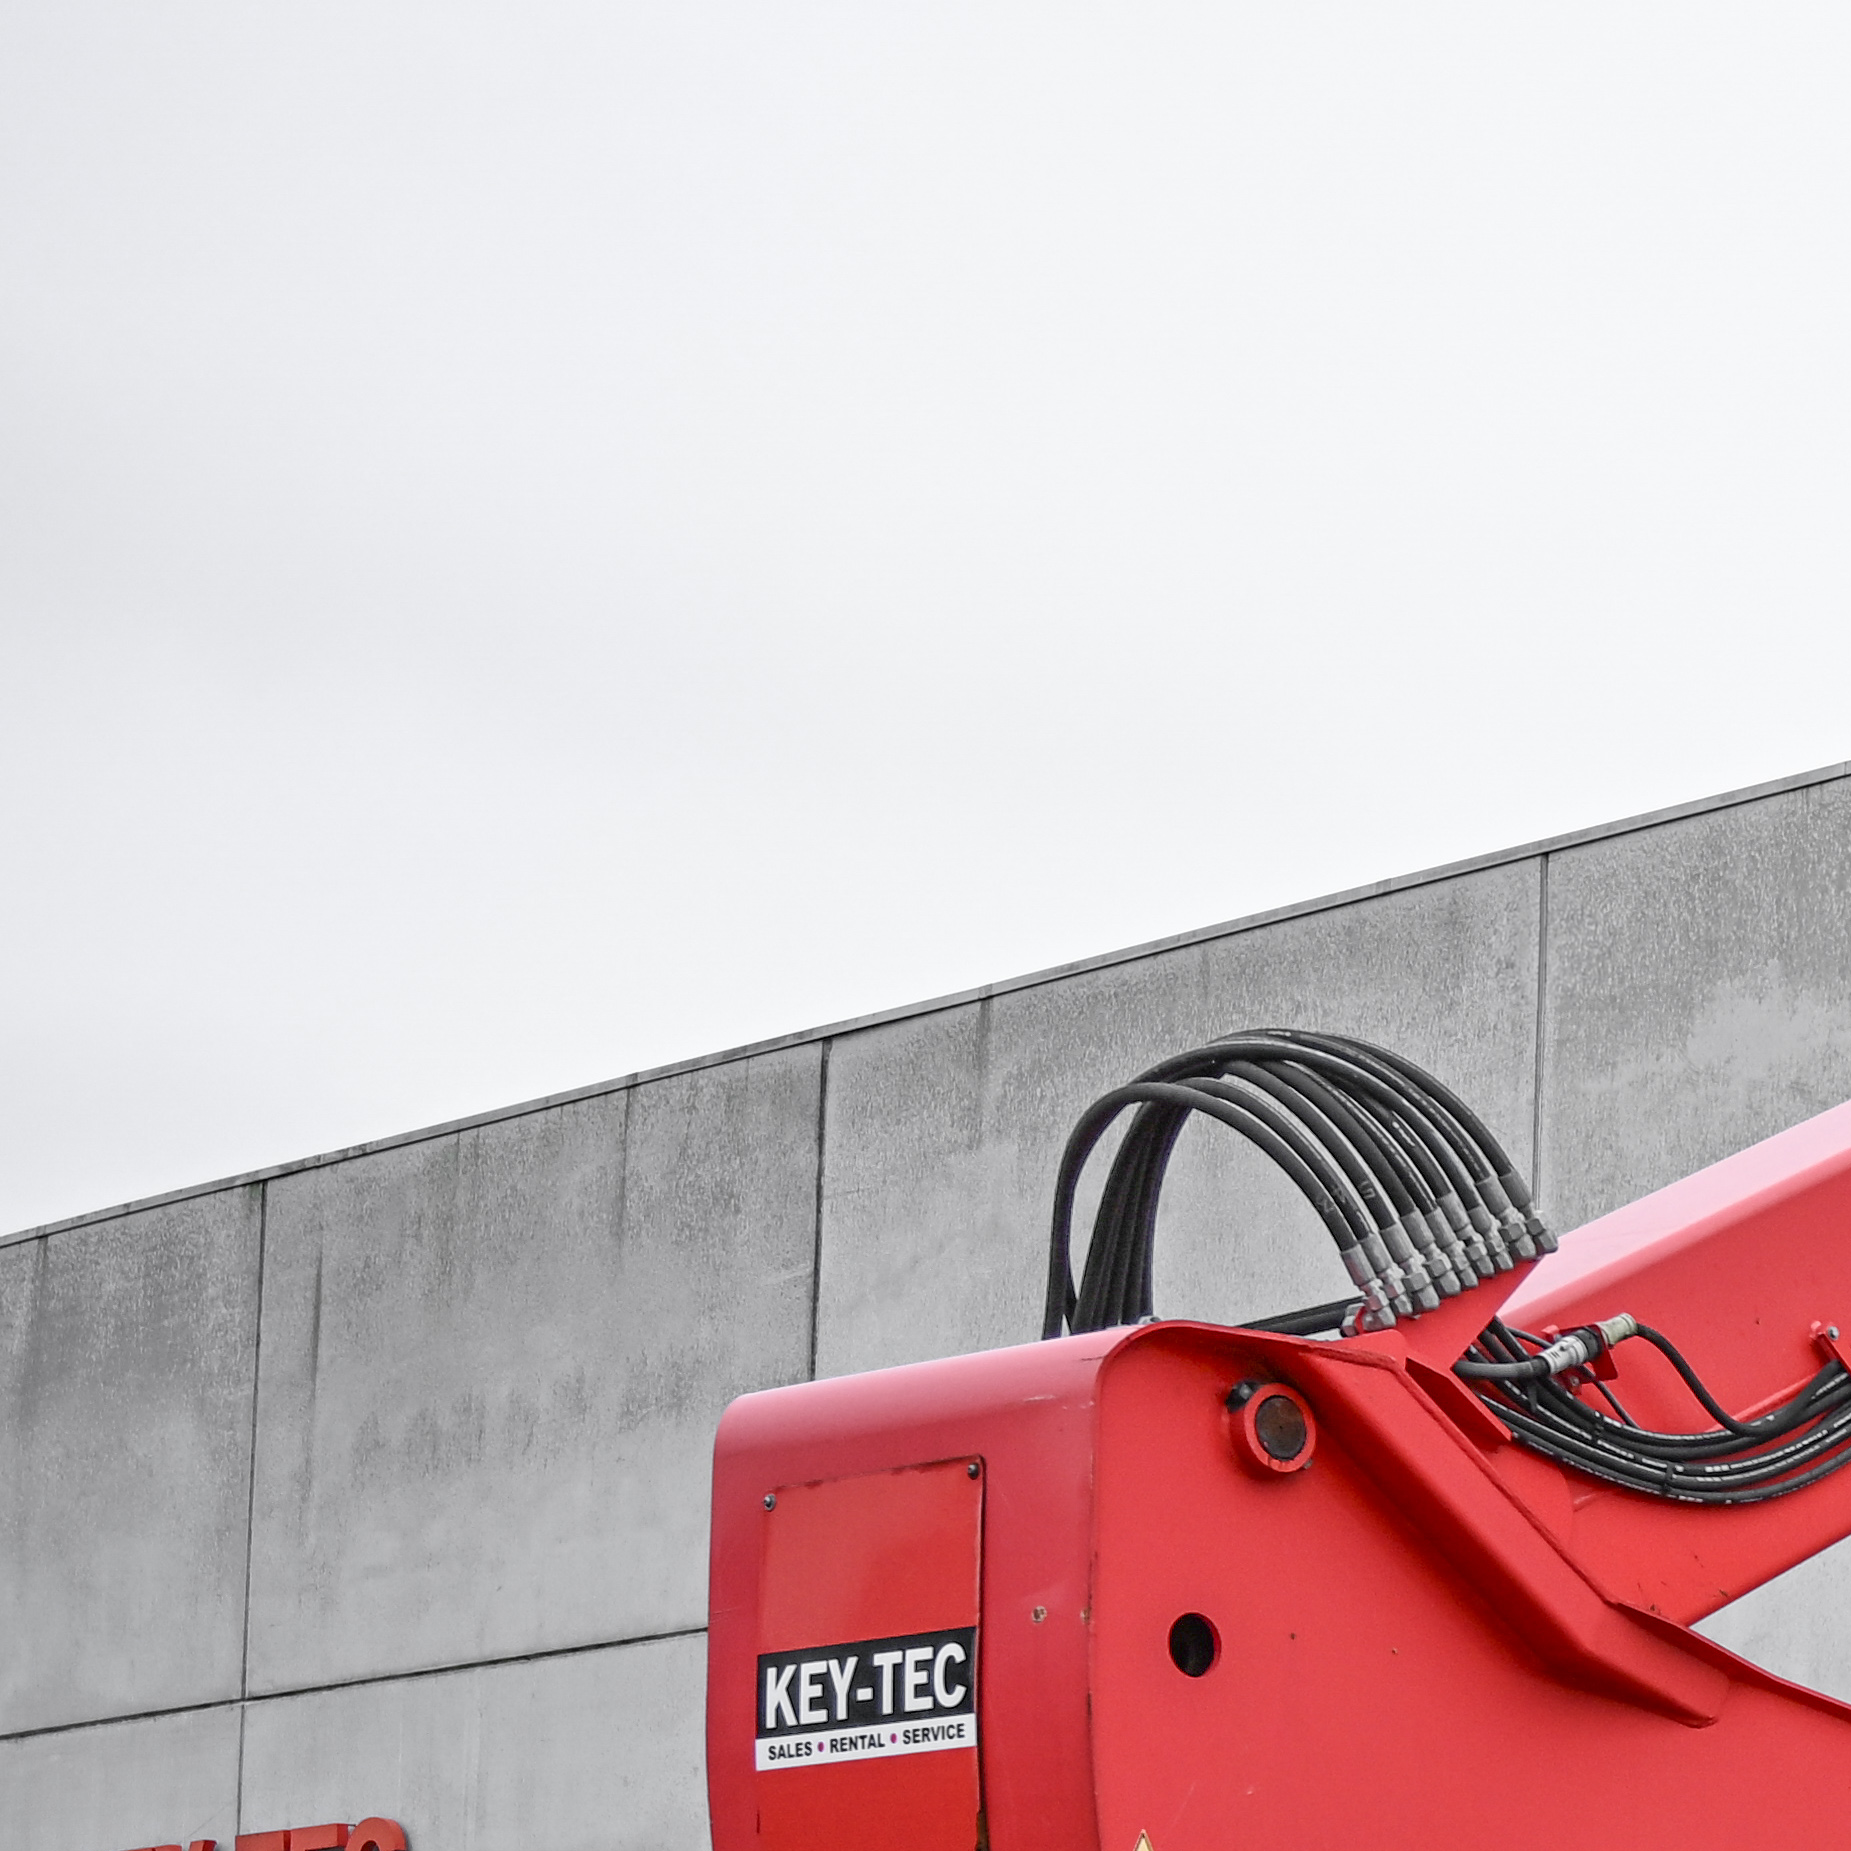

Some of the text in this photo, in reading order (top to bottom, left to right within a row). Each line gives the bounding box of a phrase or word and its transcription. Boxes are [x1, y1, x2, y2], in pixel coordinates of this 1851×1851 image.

[765, 1642, 967, 1729] KEY-TEC
[768, 1723, 965, 1760] SALES RENTAL SERVICE
